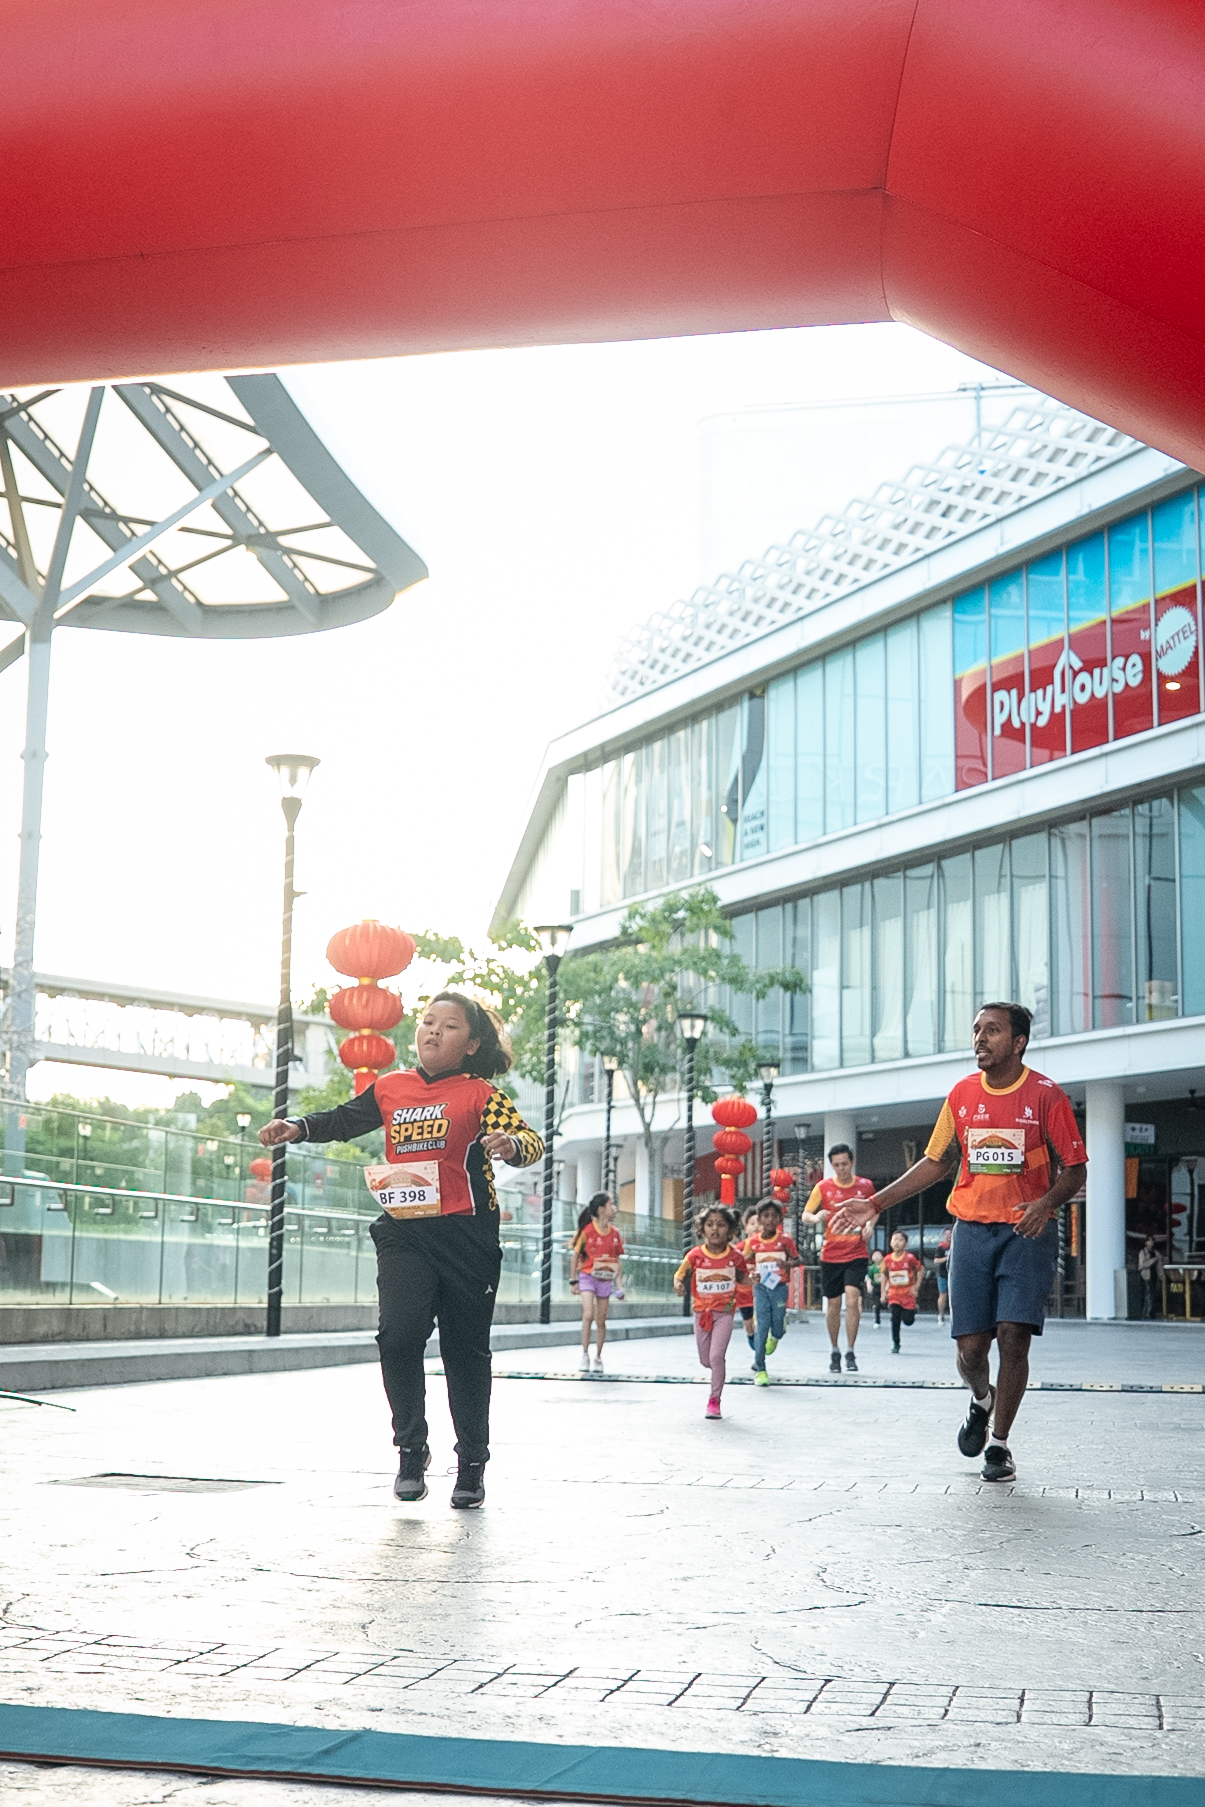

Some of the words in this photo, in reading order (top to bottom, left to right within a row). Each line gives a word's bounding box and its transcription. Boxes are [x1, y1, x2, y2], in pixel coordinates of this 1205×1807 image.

[1140, 628, 1150, 641] by
[1156, 621, 1196, 660] MATTEL
[392, 1103, 448, 1125] SHARK
[390, 1119, 449, 1144] SPEED
[976, 1151, 990, 1162] PG
[992, 1151, 1014, 1162] 015
[379, 1191, 395, 1205] BF
[399, 1189, 427, 1203] 398
[702, 1283, 715, 1291] AF
[716, 1282, 730, 1291] 107
